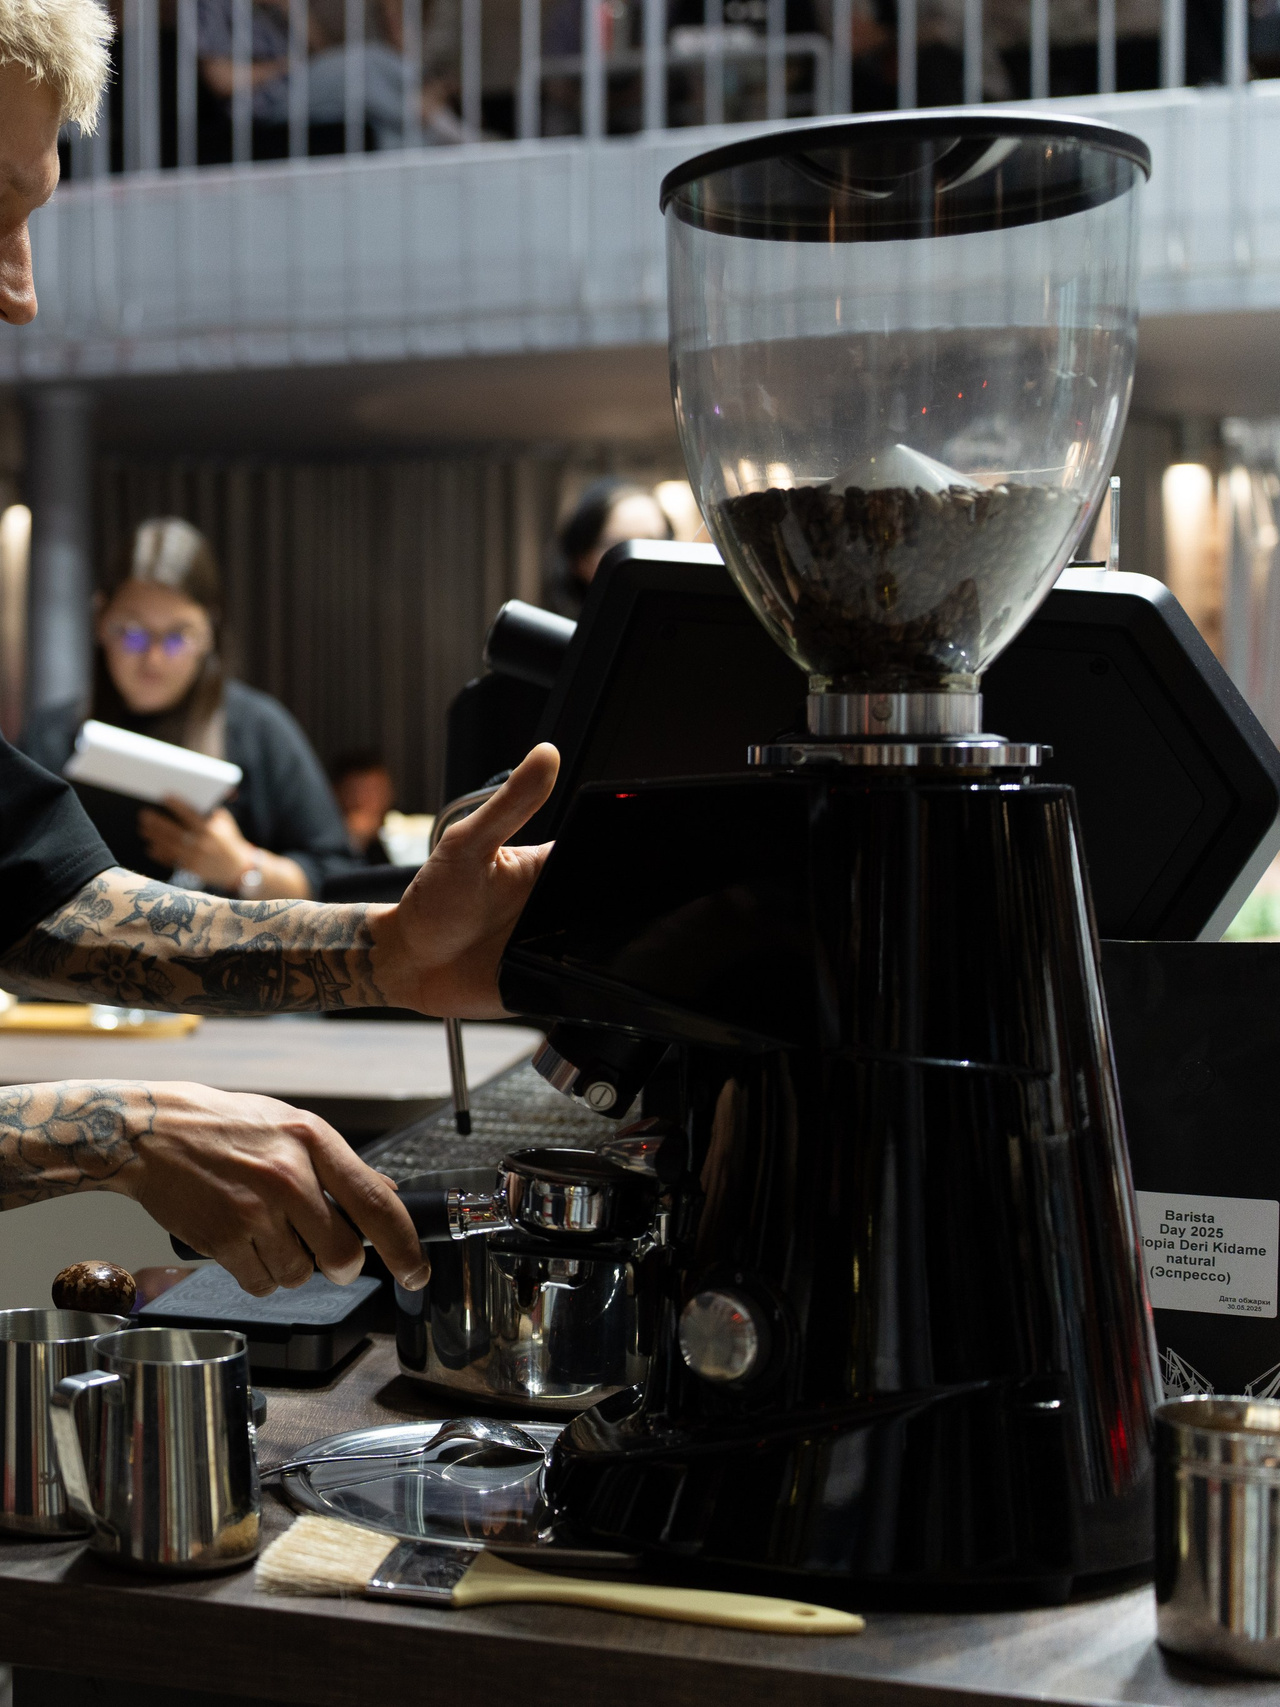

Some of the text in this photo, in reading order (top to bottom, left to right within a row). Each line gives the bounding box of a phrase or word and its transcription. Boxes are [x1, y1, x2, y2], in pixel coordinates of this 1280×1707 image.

[1165, 1209, 1215, 1224] Barista
[1160, 1223, 1224, 1239] Day 2025
[1141, 1236, 1267, 1256] iopia Deri Kidame
[1166, 1254, 1216, 1267] natural
[1150, 1265, 1231, 1285] (Эспрессо)
[1219, 1295, 1271, 1306] Дата обжарки
